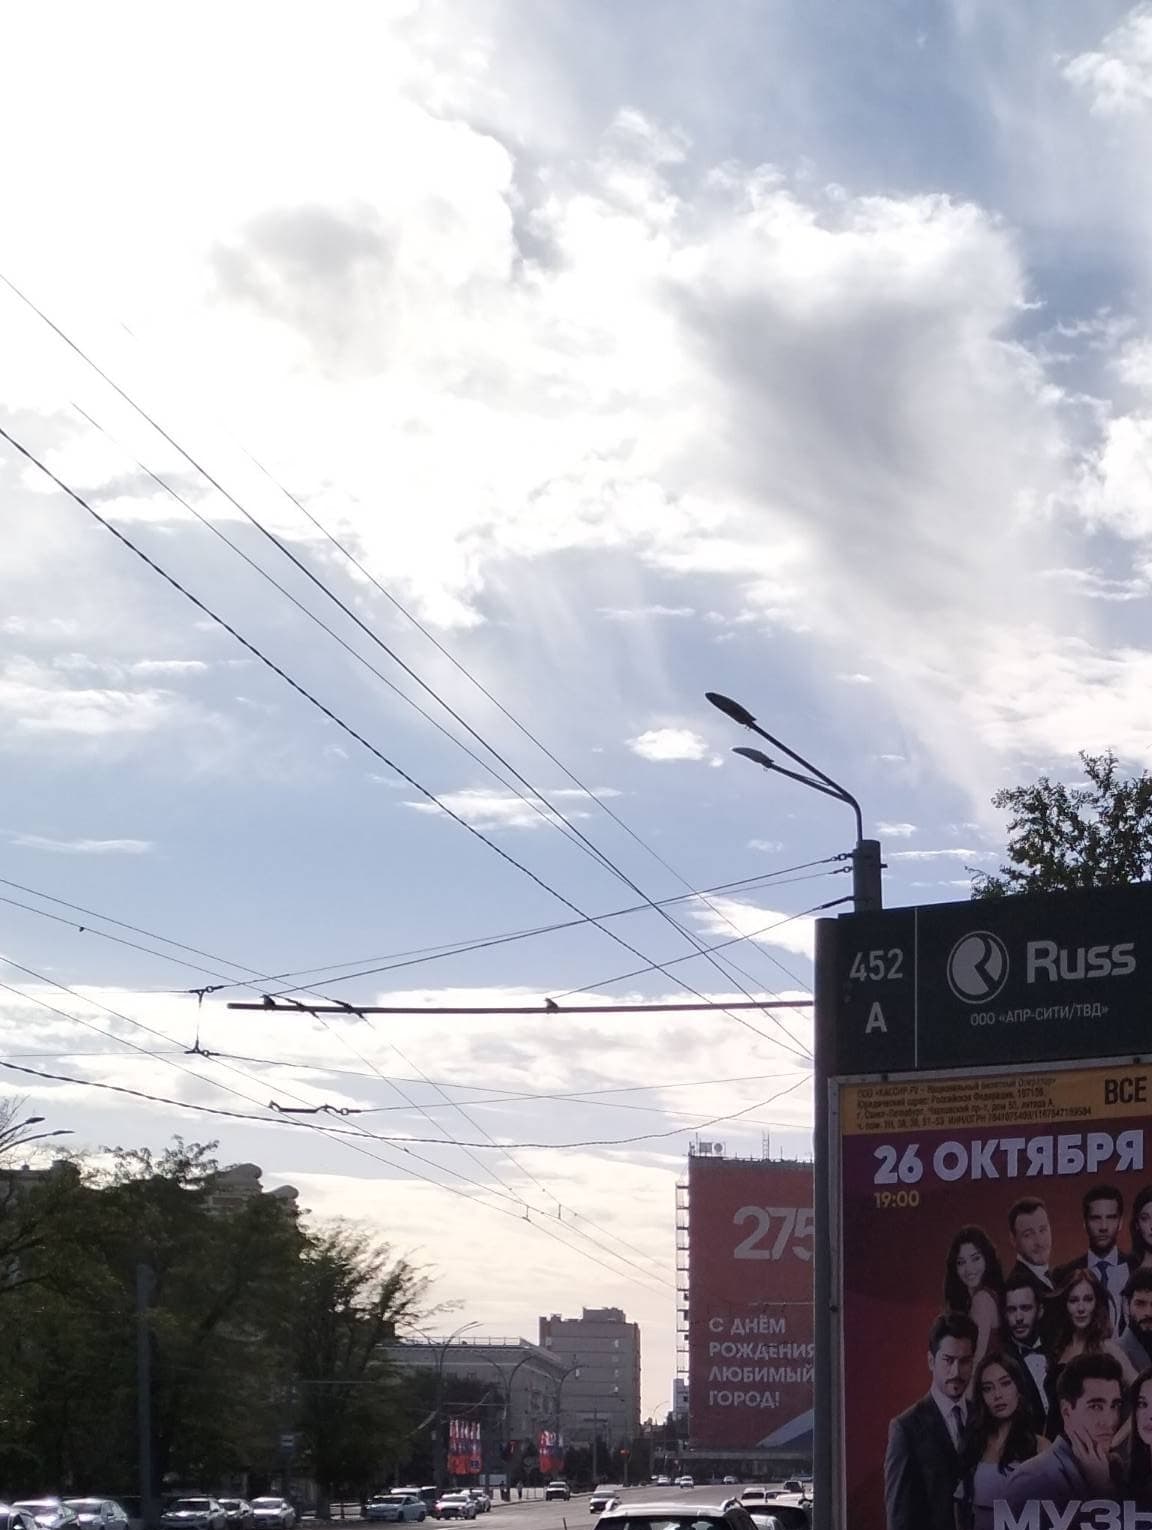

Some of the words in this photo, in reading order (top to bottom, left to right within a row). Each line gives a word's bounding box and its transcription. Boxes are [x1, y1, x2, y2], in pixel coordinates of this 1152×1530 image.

[849, 949, 903, 981] 452
[1027, 940, 1136, 984] Russ
[1105, 1076, 1147, 1104] ВСЕ
[873, 1144, 923, 1184] 26
[933, 1130, 1143, 1181] ОКТЯБРЯ
[874, 1190, 919, 1208] 19:00
[733, 1205, 815, 1261] 275
[709, 1318, 724, 1333] С
[731, 1316, 785, 1336] ДНЁМ
[709, 1363, 815, 1383] ЛЮБИМЫЙ
[709, 1391, 780, 1408] ГОРОД!
